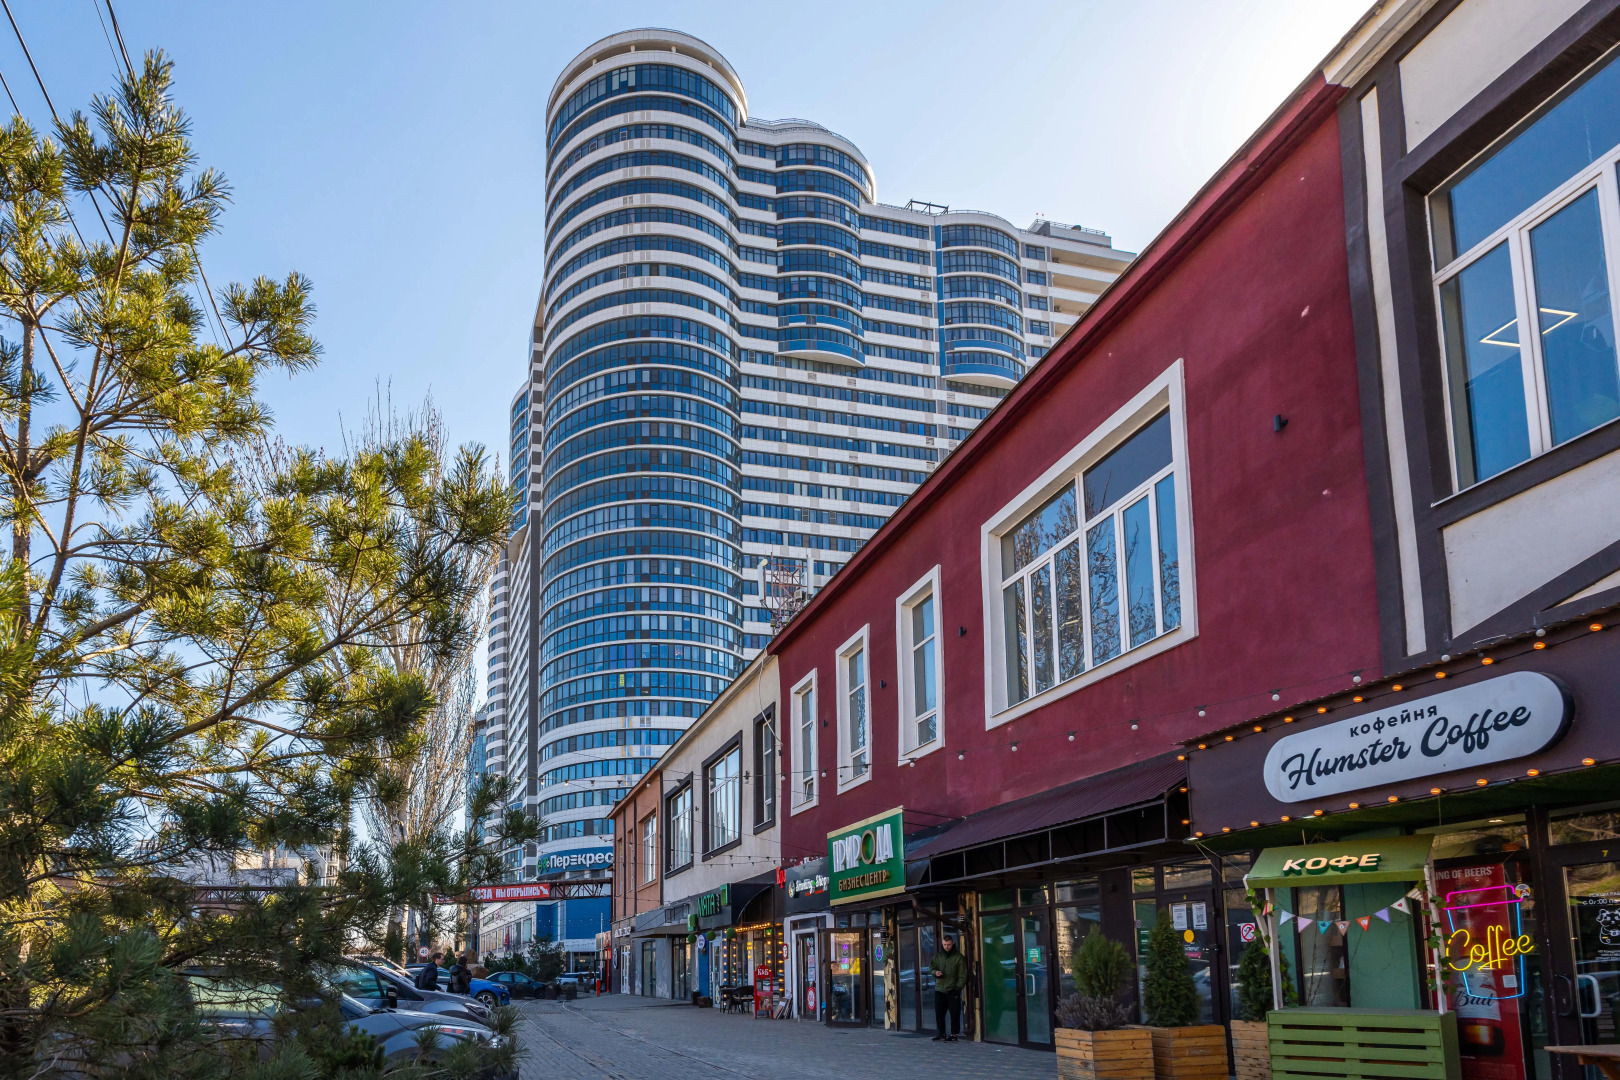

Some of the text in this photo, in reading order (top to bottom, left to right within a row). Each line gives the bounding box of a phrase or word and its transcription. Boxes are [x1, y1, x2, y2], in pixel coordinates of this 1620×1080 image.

[1349, 705, 1438, 738] кофейня
[1281, 705, 1532, 790] Humster Coffee
[833, 824, 894, 873] ПРИРОДА
[1282, 853, 1383, 876] КОФЕ
[1434, 871, 1450, 880] ING
[1451, 869, 1463, 879] OF
[495, 888, 506, 899] МЫ
[506, 885, 540, 898] ОТКРЫЛИСЬ
[1446, 925, 1535, 971] Coffee
[1456, 989, 1493, 1007] Bud
